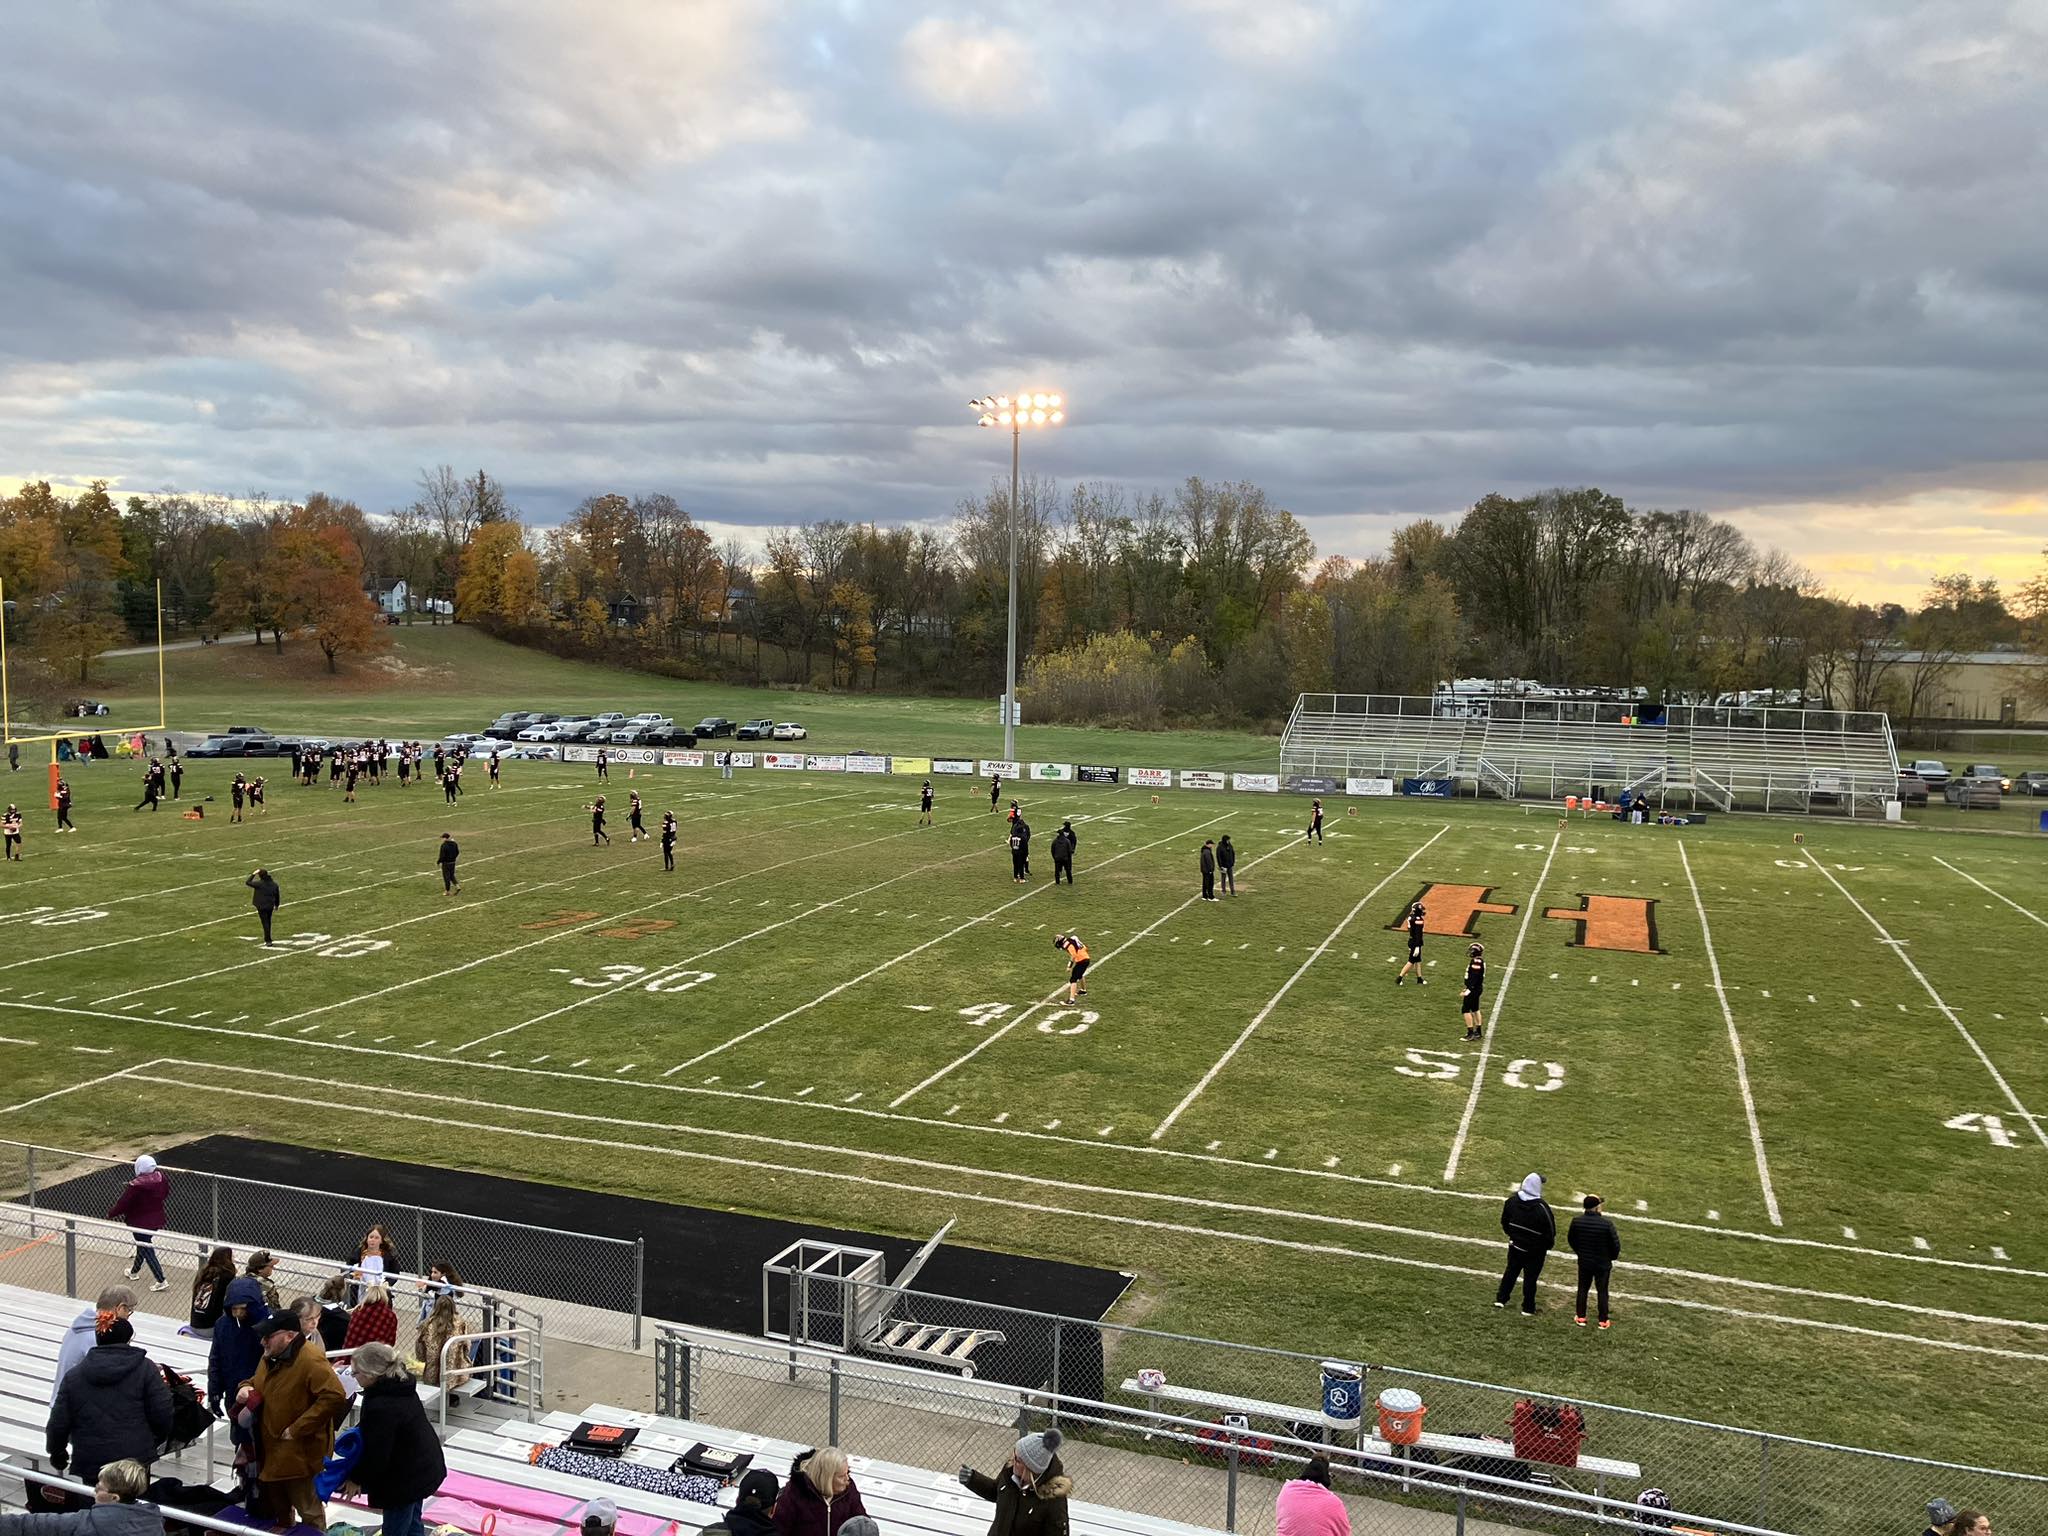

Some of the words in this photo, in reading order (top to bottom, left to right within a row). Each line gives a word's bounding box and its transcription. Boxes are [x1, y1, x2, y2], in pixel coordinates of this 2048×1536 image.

[987, 762, 1013, 770] RYAN'S
[1794, 834, 1803, 844] 40
[958, 1002, 1100, 1035] 40
[1394, 1048, 1565, 1091] 50
[1393, 1420, 1402, 1429] G
